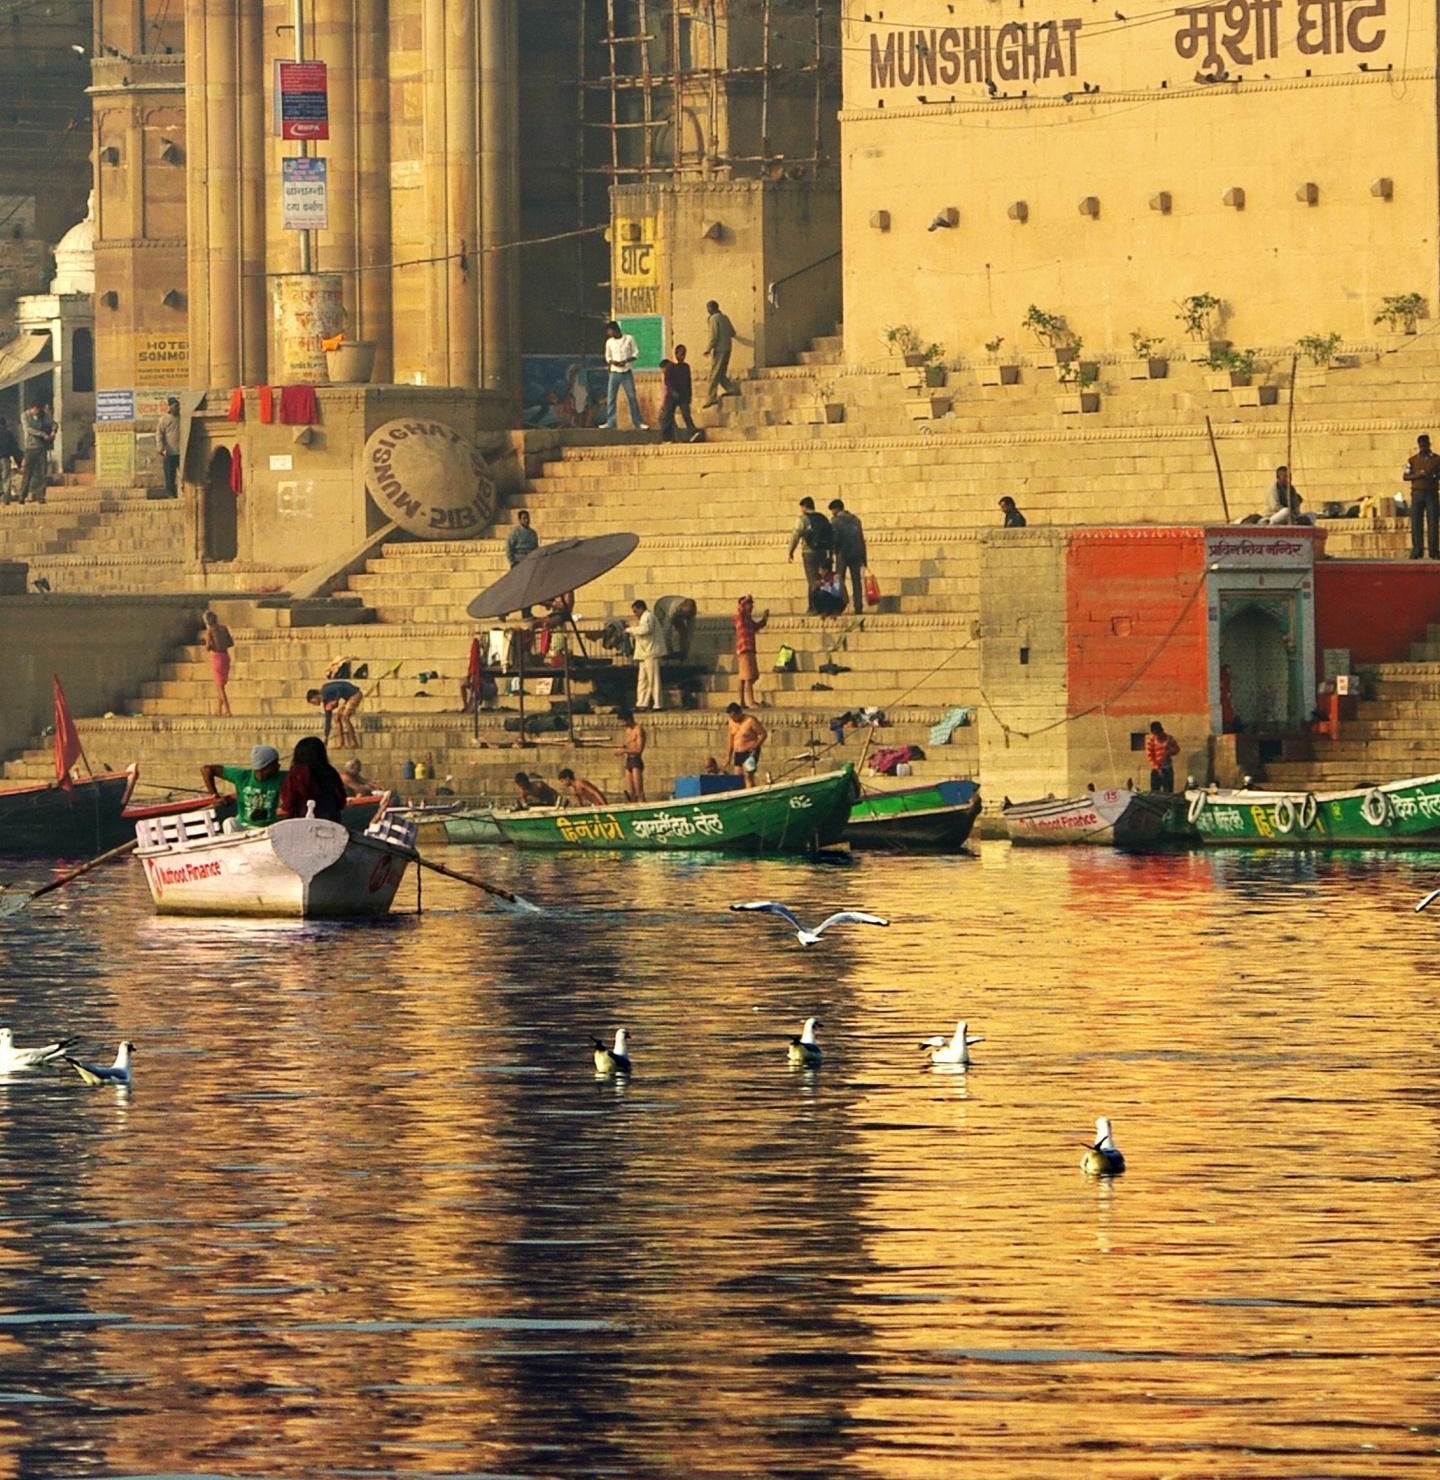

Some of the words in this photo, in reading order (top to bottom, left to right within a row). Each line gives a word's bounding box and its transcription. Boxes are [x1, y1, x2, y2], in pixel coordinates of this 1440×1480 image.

[621, 243, 654, 275] घाट
[790, 795, 813, 808] 62
[186, 861, 222, 881] Finance
